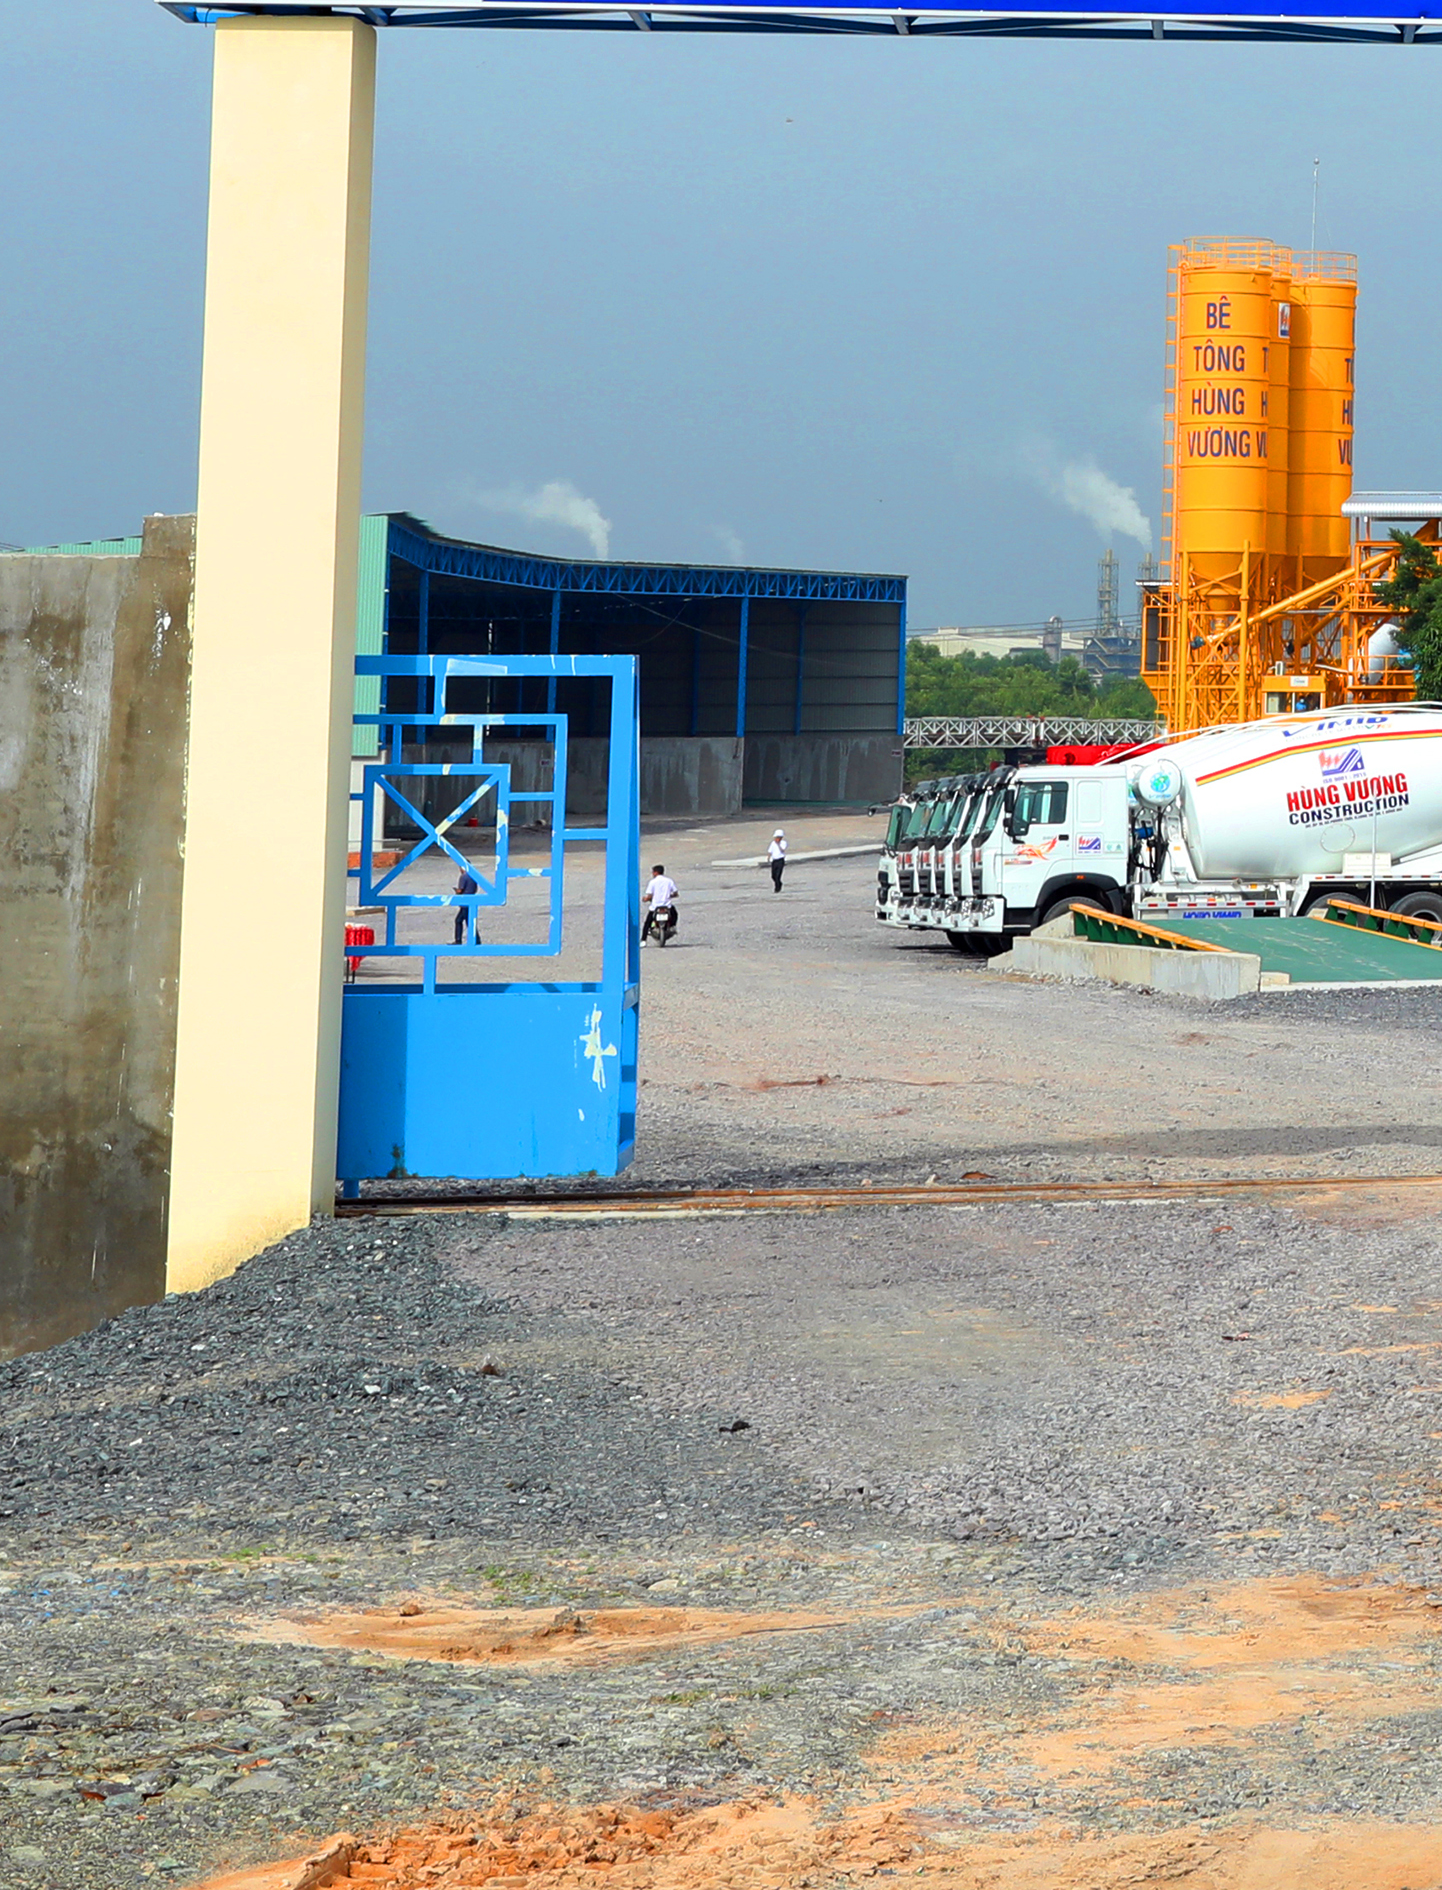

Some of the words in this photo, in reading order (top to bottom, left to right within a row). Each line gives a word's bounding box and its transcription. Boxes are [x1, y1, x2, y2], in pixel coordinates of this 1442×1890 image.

[1206, 295, 1231, 329] BÊ
[1193, 338, 1245, 372] TÔNG
[1191, 381, 1245, 415] HÙNG
[1187, 426, 1251, 458] VƯƠNG
[1287, 785, 1340, 812] HÙNG
[1343, 773, 1408, 802] VƯƠNG
[1289, 793, 1409, 825] CONSTRUCTION
